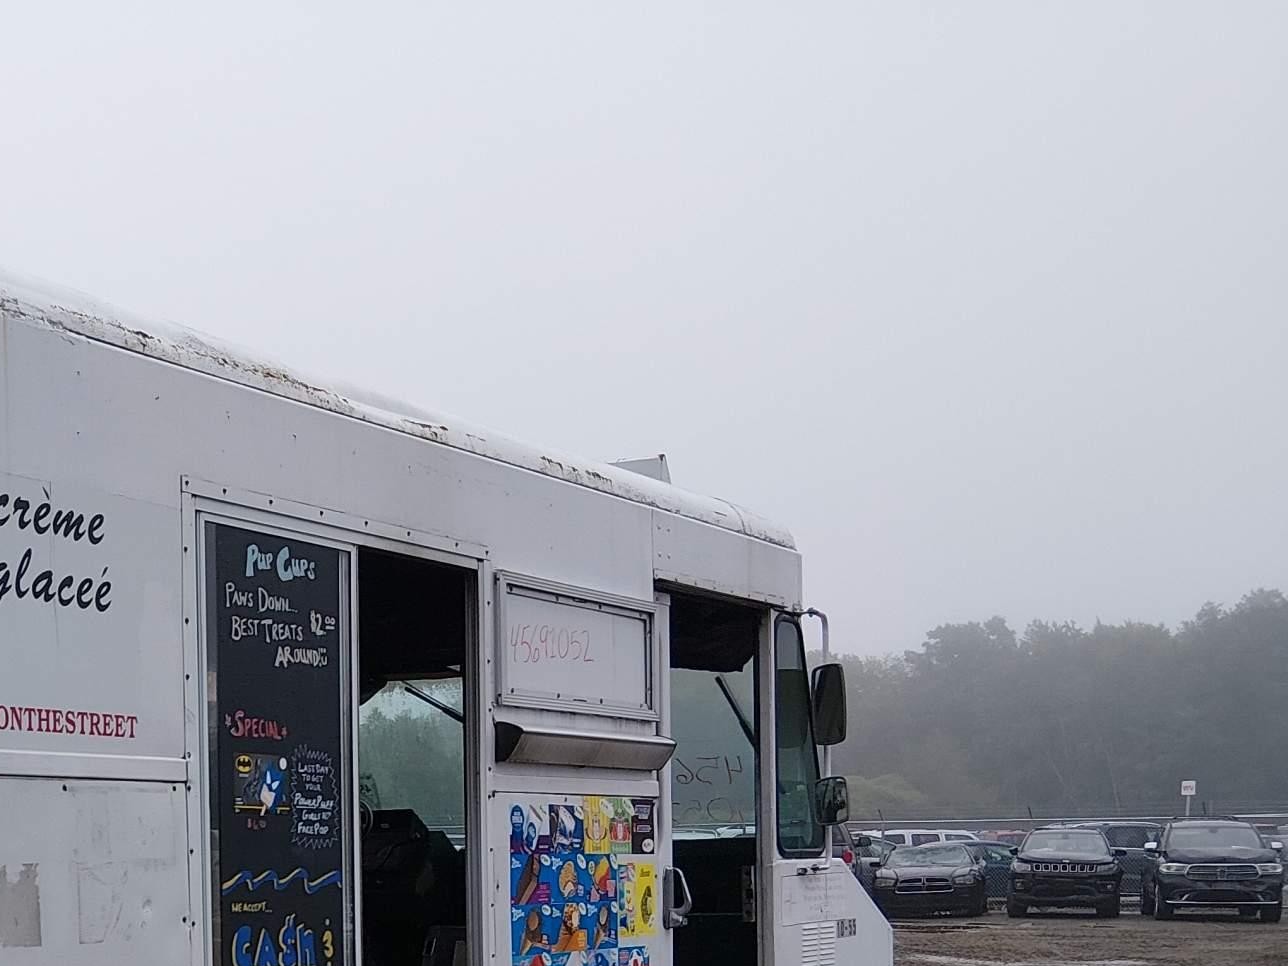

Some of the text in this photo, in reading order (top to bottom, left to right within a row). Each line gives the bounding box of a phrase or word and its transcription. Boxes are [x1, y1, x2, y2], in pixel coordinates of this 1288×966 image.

[276, 546, 316, 582] CUPS
[231, 615, 260, 641] BEST
[260, 618, 304, 644] TREATS
